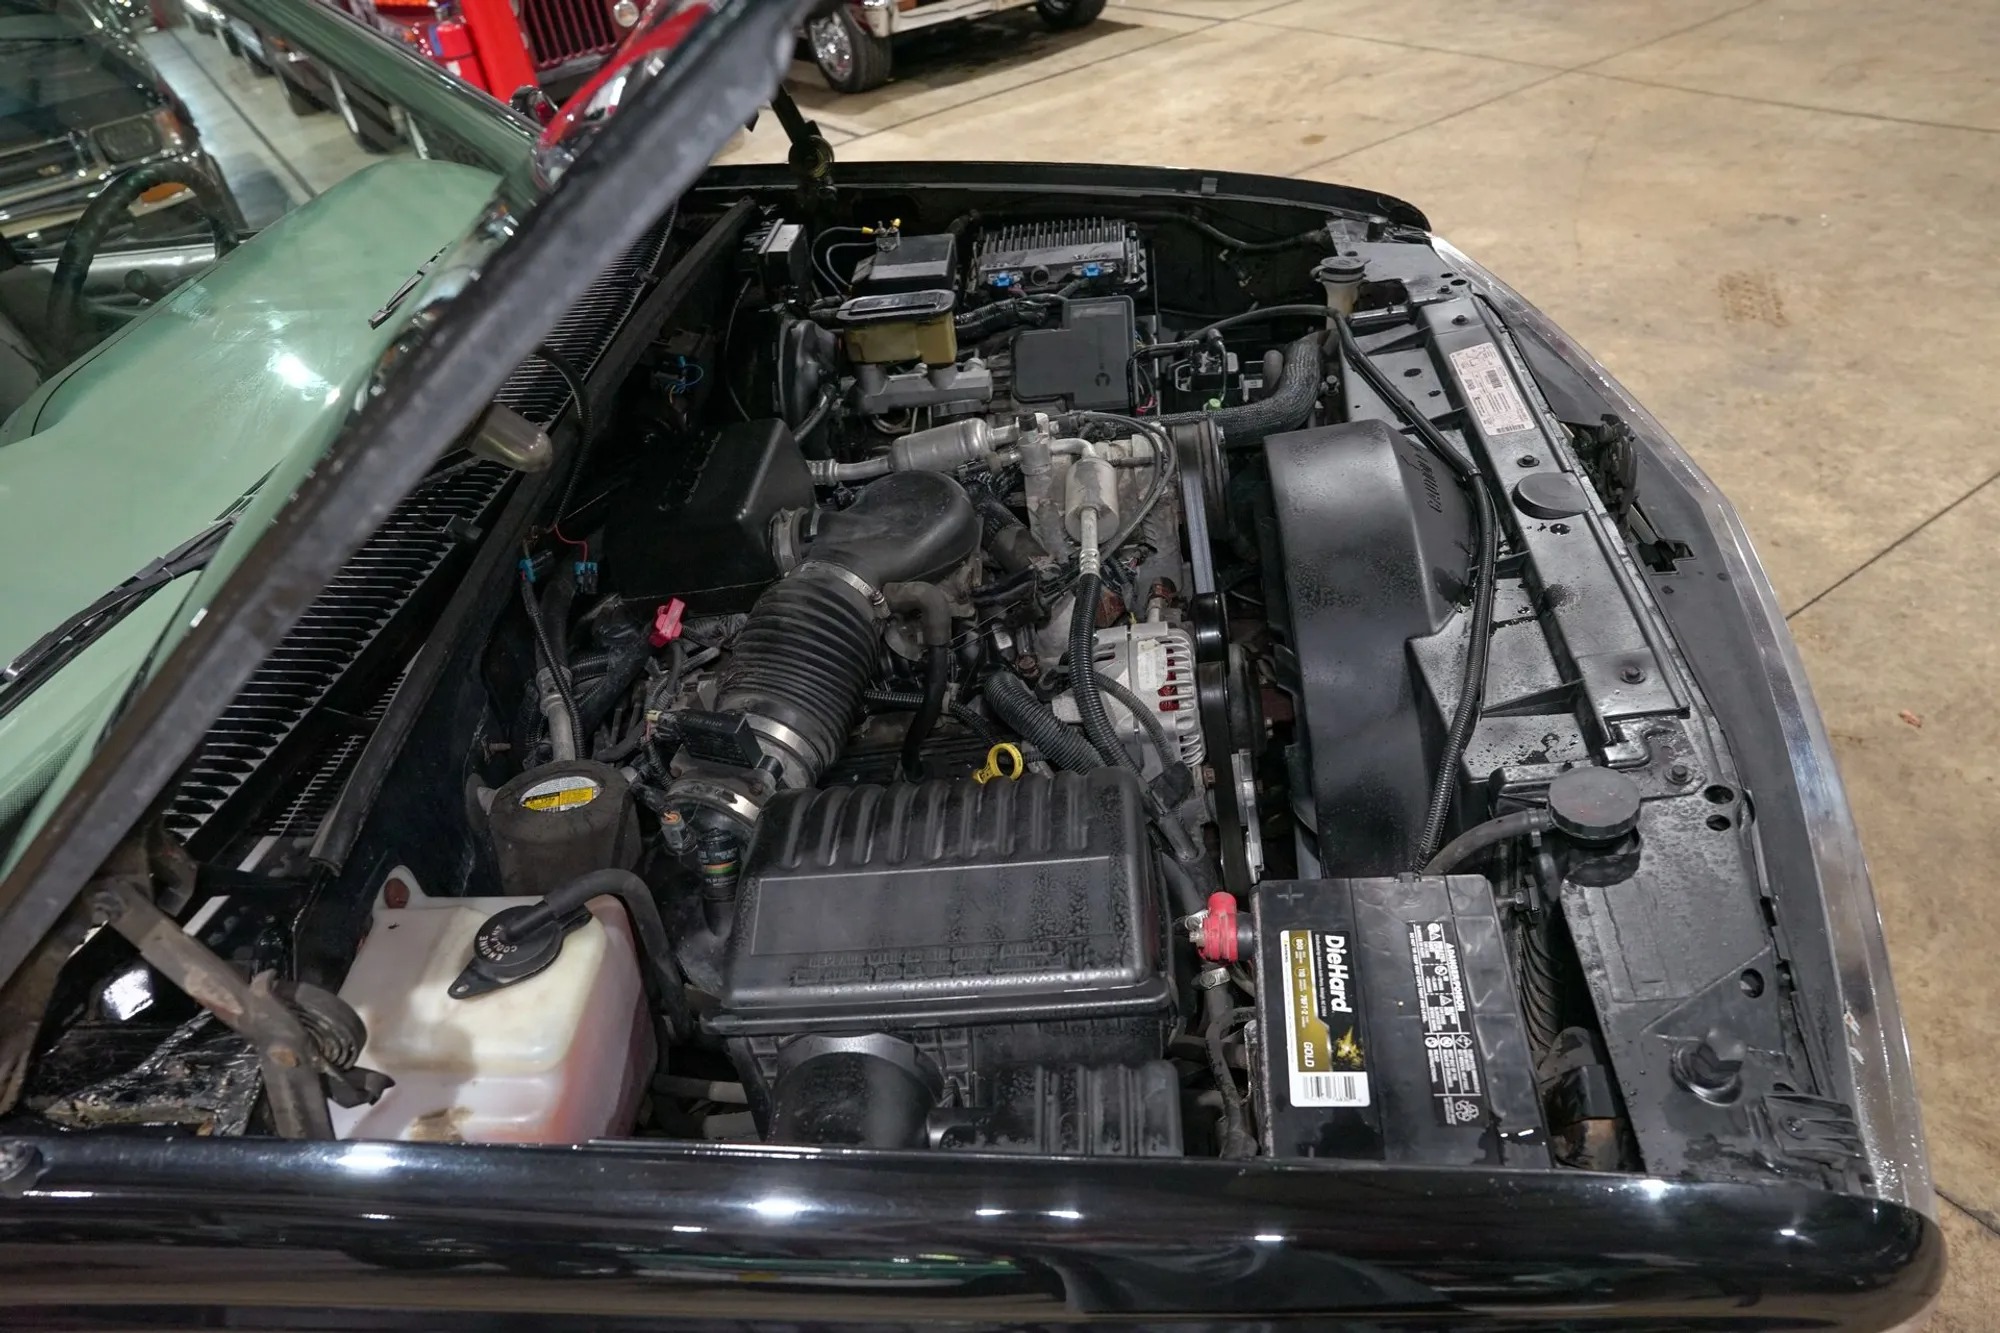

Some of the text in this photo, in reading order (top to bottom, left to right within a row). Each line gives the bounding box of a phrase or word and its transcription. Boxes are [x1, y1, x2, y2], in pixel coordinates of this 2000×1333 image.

[479, 935, 504, 961] ENGINE
[1324, 935, 1354, 1012] DieHard
[1446, 949, 1465, 1011] DANGER/POISON
[1303, 1041, 1314, 1067] GOLD
